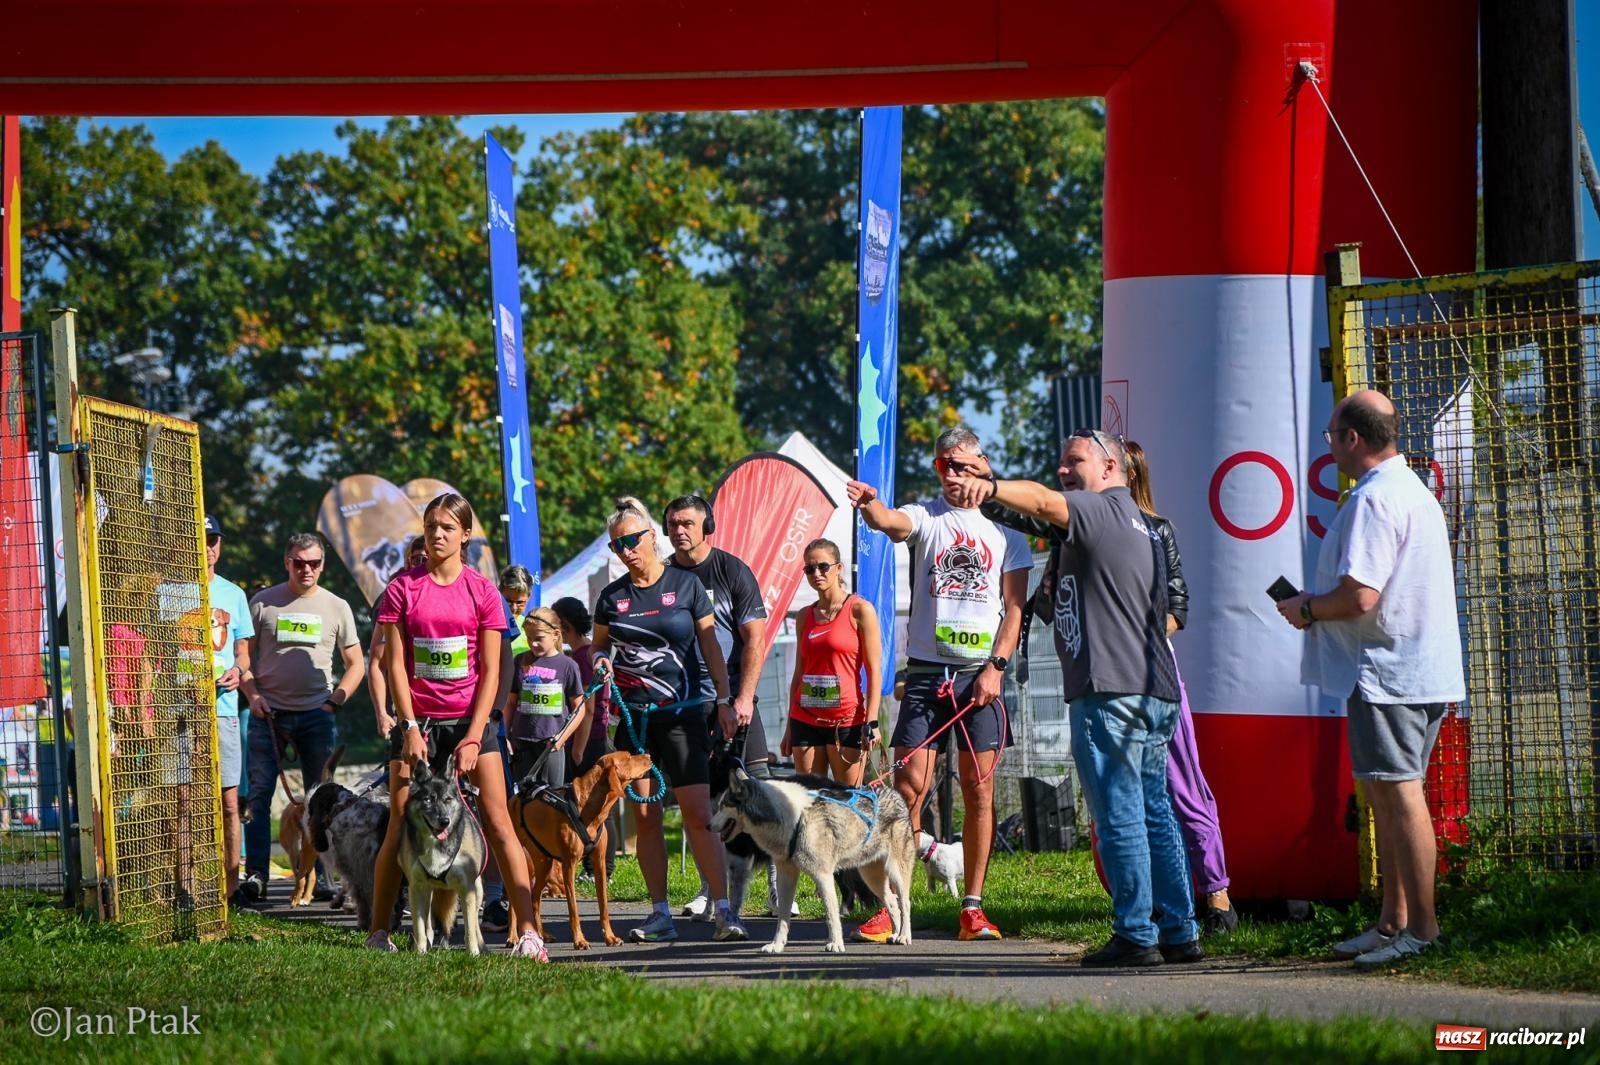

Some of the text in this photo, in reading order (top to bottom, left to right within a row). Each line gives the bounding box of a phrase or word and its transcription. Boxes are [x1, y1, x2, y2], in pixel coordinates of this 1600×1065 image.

[291, 622, 308, 632] 79
[948, 631, 980, 646] 100
[430, 652, 453, 666] 99
[810, 686, 827, 697] 98
[532, 694, 549, 705] 86
